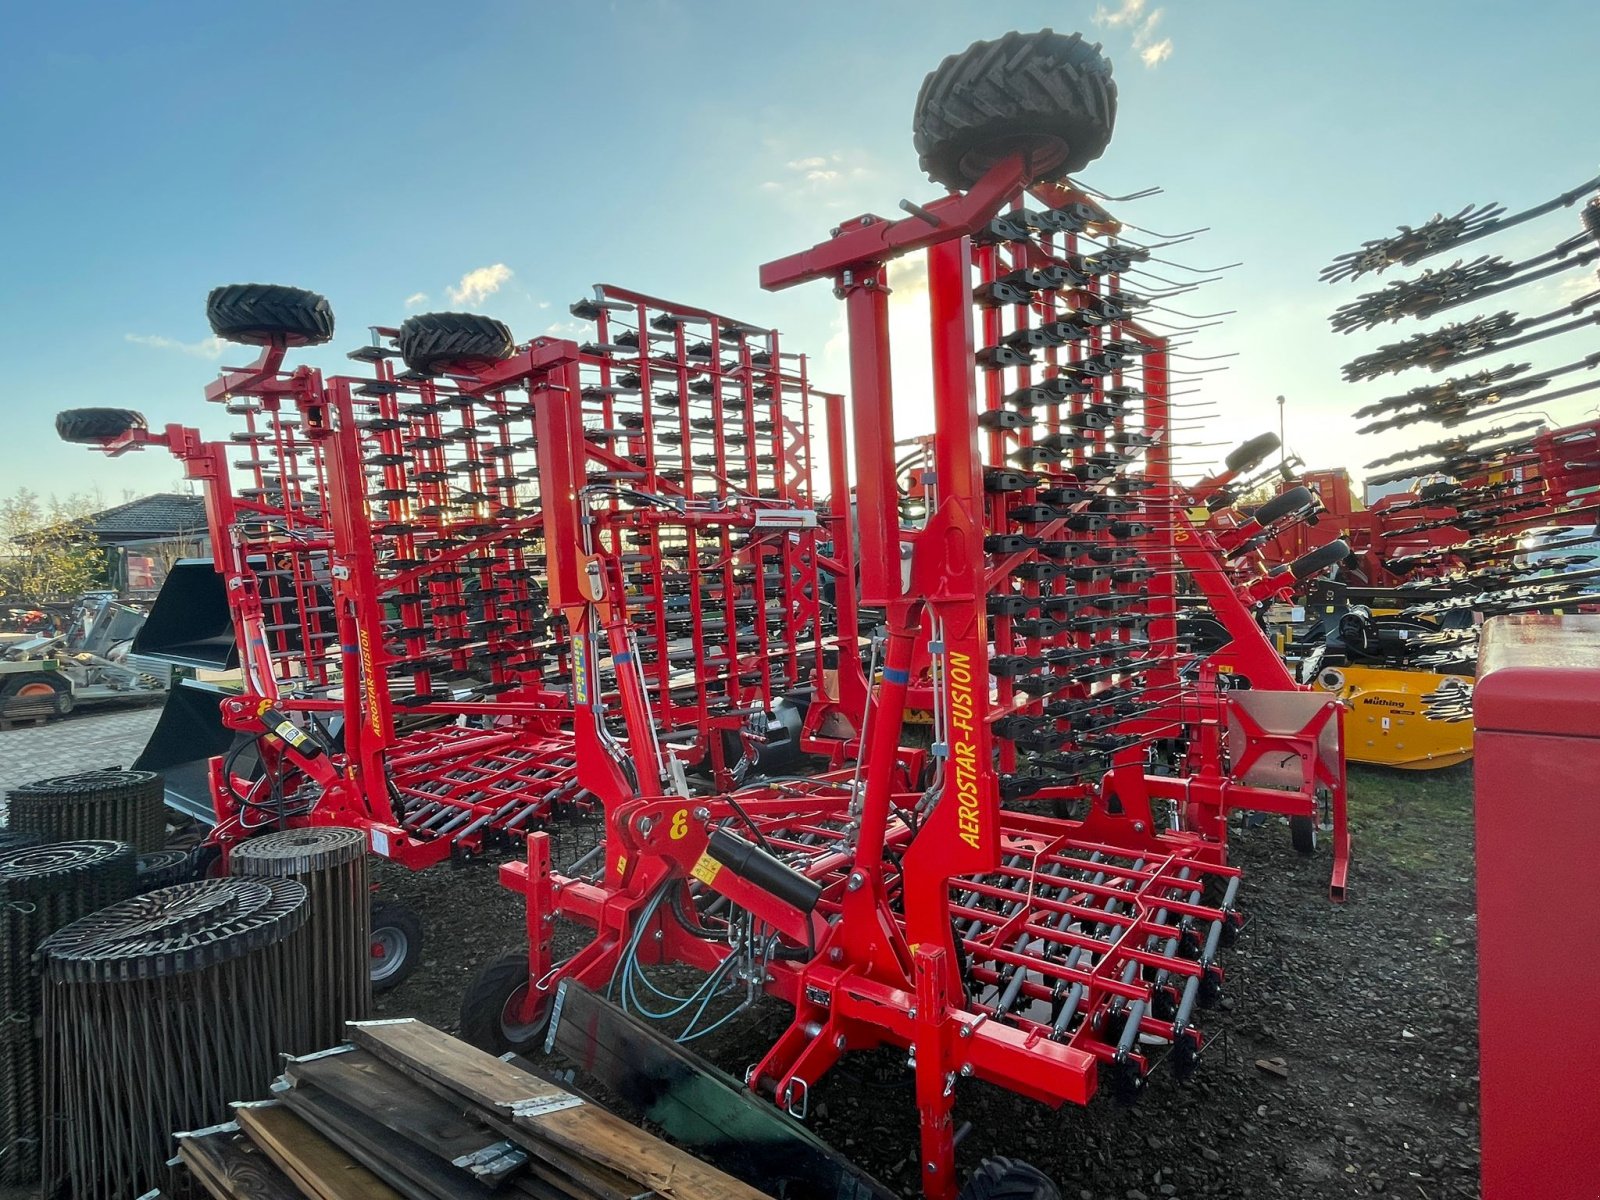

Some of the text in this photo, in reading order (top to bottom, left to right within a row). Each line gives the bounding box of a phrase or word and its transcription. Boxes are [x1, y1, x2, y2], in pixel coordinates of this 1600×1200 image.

[360, 630, 381, 737] AEROSTAR-FUSION
[573, 637, 586, 702] Einböck
[1363, 696, 1405, 708] Müthing
[950, 651, 980, 849] AEROSTAR-FUSION
